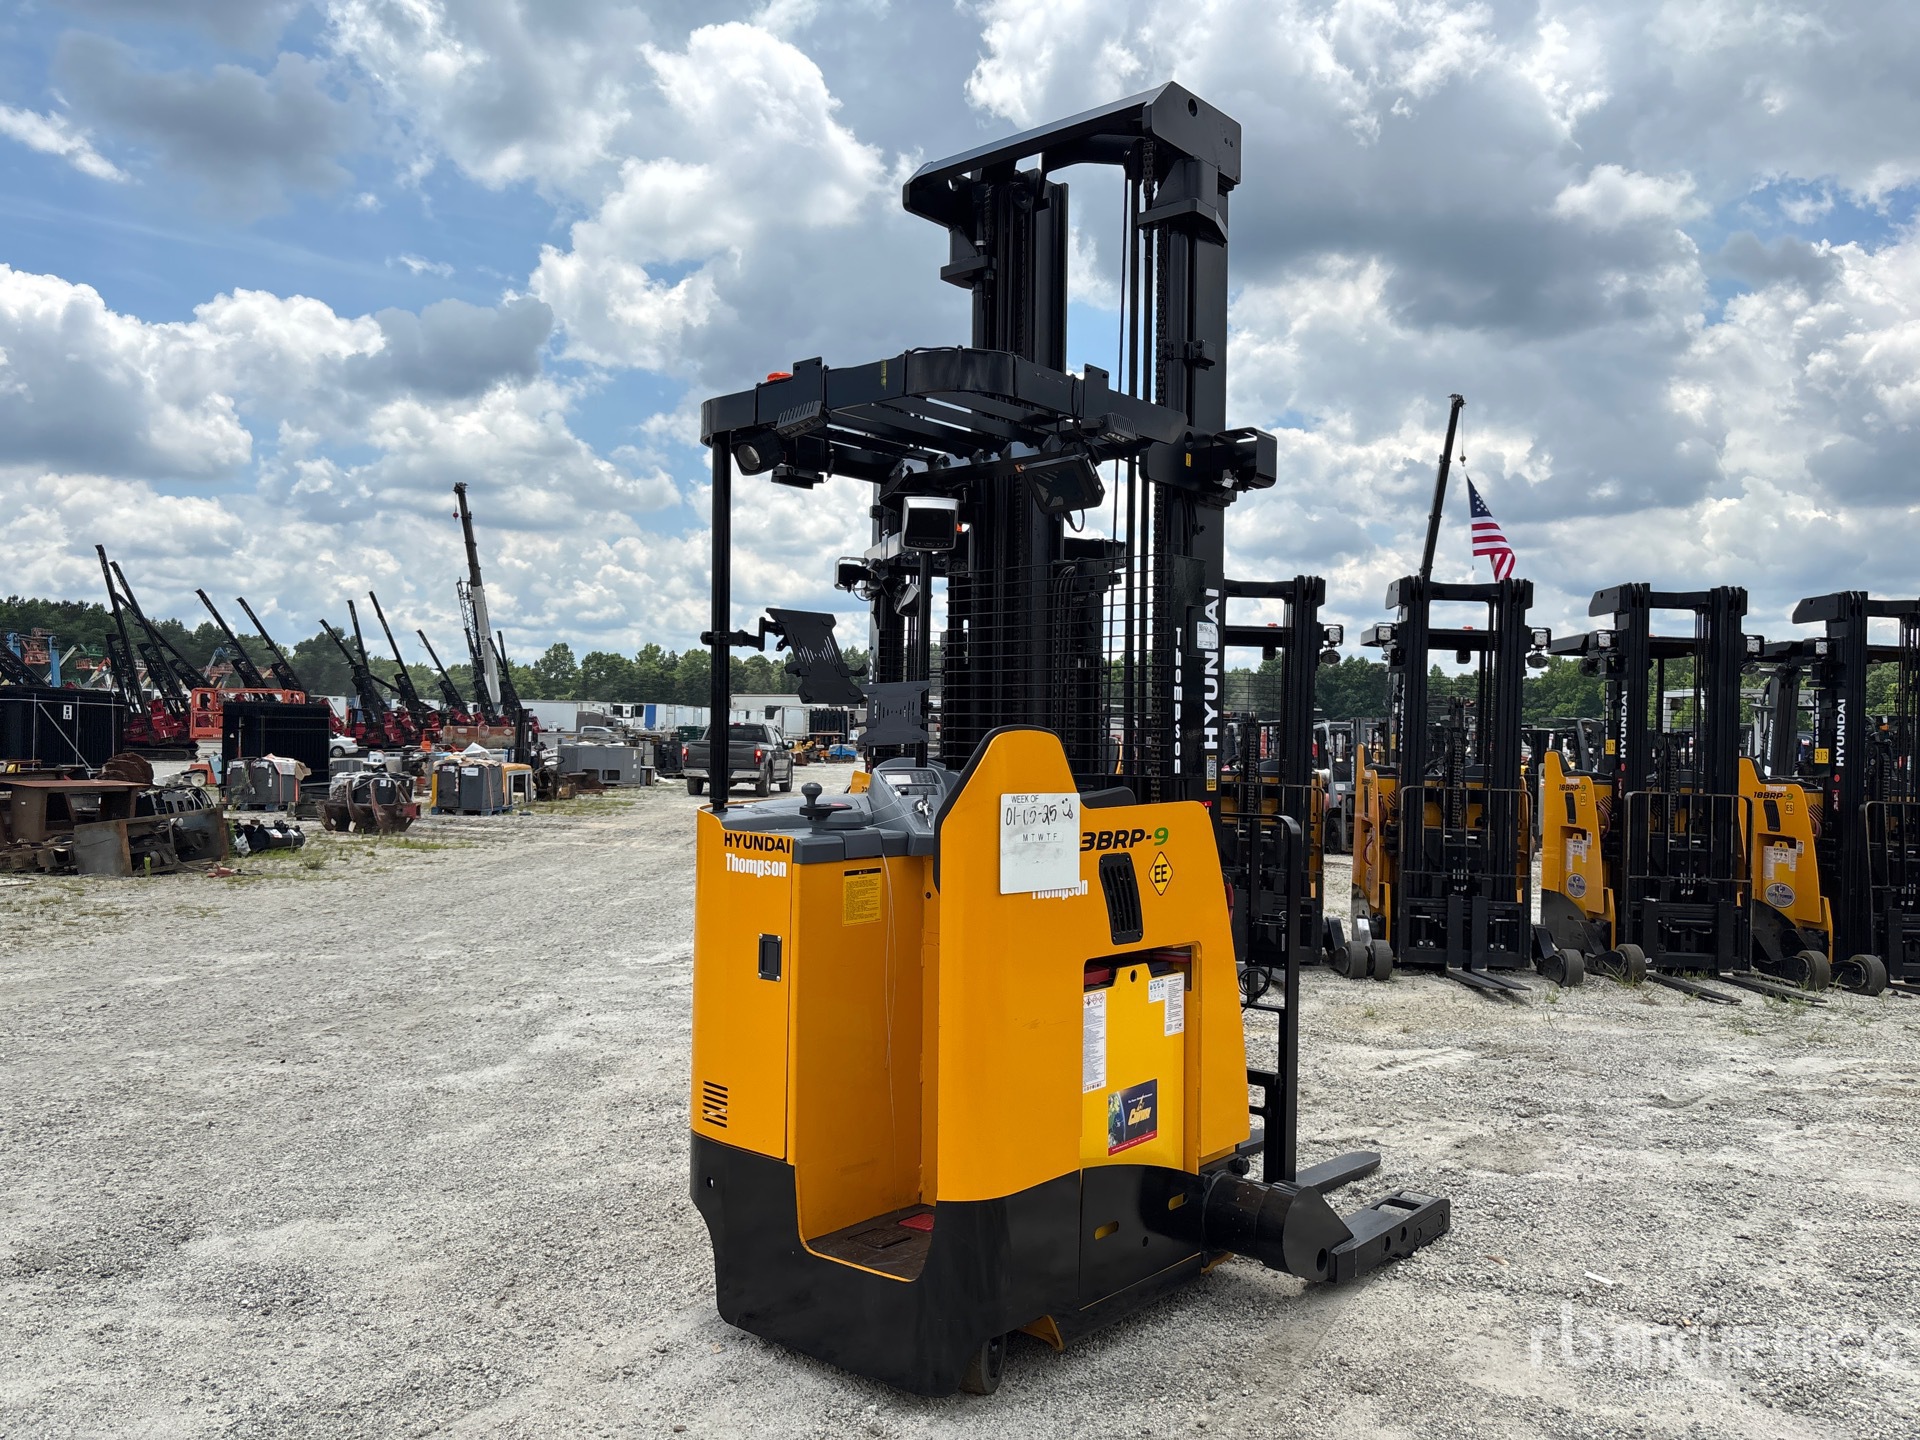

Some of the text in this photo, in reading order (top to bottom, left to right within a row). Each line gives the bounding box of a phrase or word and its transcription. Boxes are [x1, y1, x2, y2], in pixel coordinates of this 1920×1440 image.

[1204, 588, 1219, 749] HYUNAI
[1620, 690, 1628, 758] HYUNDAI
[1836, 698, 1846, 767] HYUNDAI
[1605, 742, 1615, 752] 312
[1815, 751, 1828, 761] 313
[1011, 795, 1040, 804] WEEK OF
[1754, 791, 1794, 800] 18BRP-9
[724, 832, 791, 854] HYUNDAI
[1023, 833, 1029, 842] M
[1037, 833, 1044, 841] W
[726, 853, 787, 877] Thompson
[1154, 863, 1168, 884] EE
